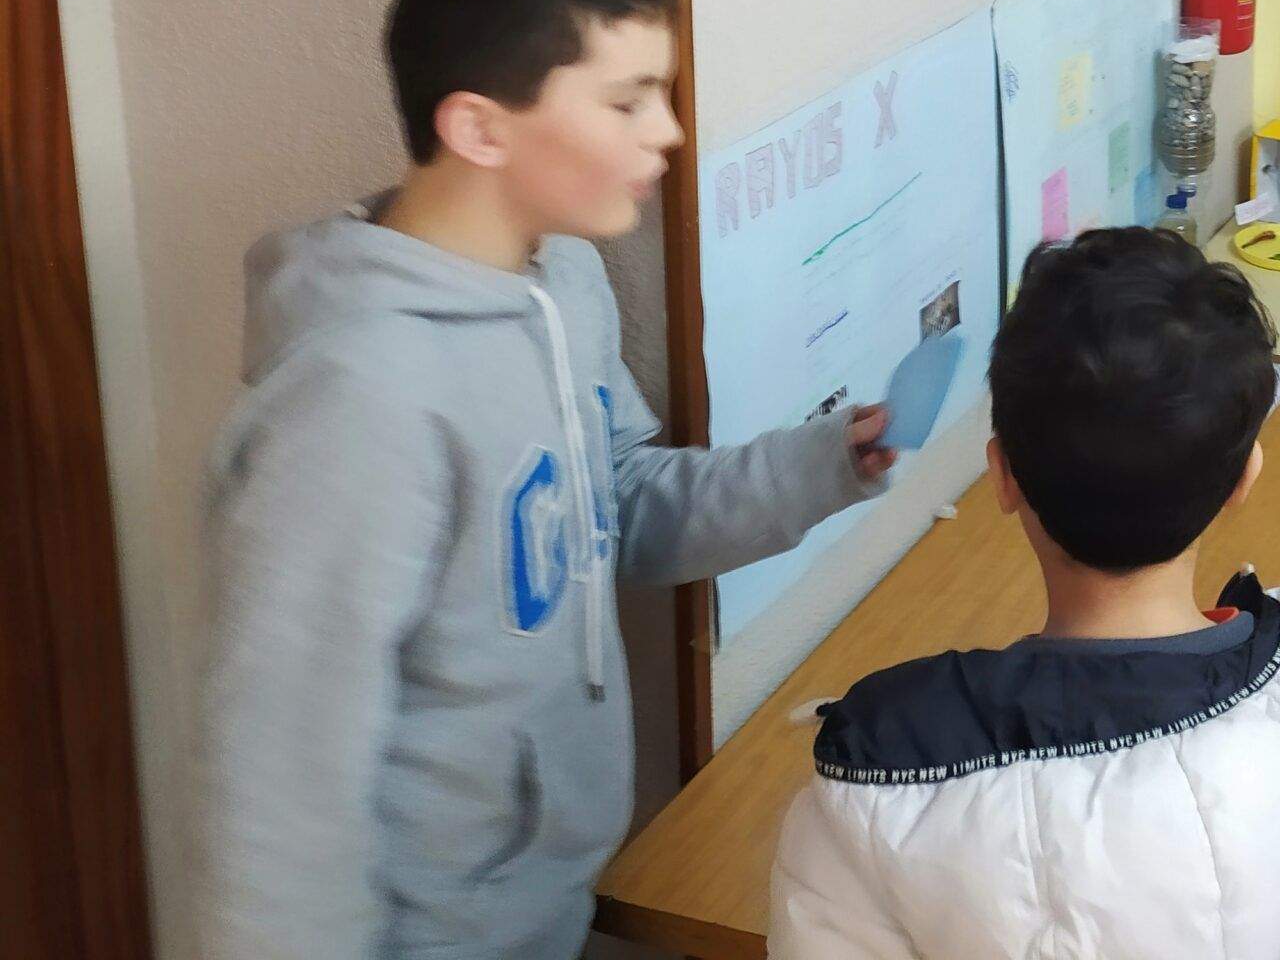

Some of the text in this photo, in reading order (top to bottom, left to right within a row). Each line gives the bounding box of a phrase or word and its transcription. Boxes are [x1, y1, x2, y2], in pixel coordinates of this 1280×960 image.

[715, 100, 844, 239] RAYOS
[872, 70, 899, 149] X
[919, 765, 949, 783] NEW
